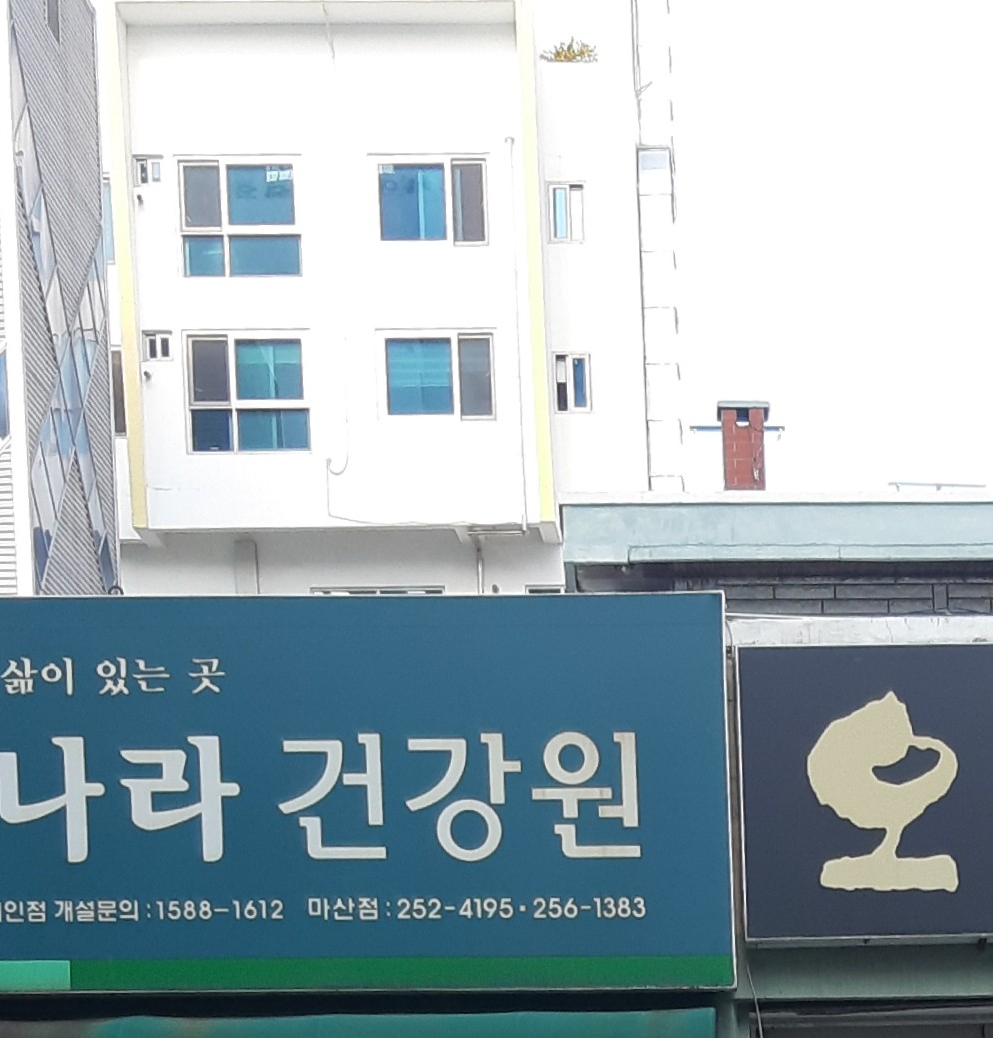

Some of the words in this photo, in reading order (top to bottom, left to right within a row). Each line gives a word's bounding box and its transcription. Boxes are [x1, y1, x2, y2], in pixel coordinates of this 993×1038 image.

[0, 656, 74, 696] 삶이
[96, 657, 171, 696] 있는
[188, 658, 226, 694] 곳
[278, 731, 642, 862] 건강원
